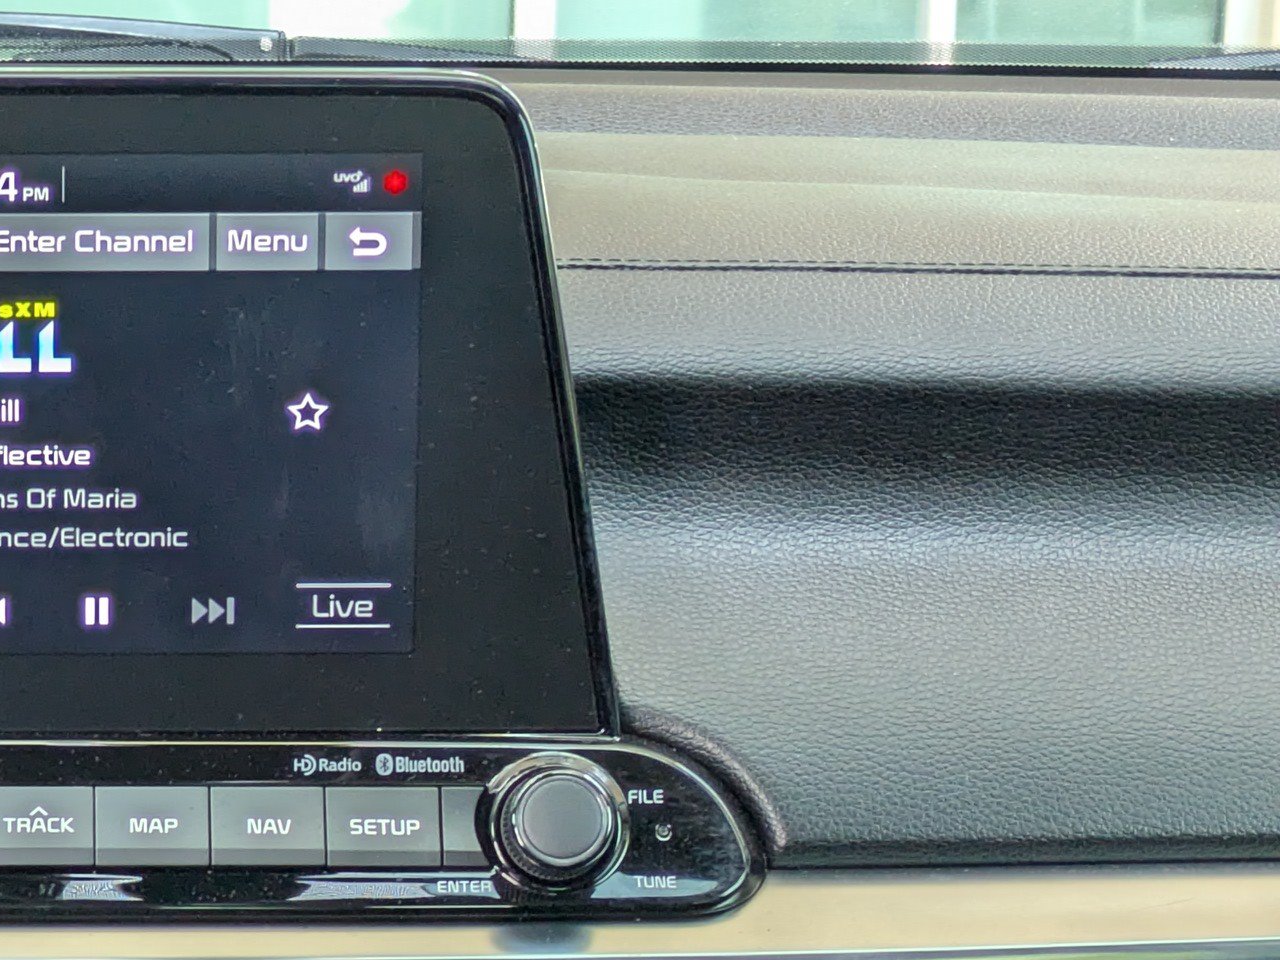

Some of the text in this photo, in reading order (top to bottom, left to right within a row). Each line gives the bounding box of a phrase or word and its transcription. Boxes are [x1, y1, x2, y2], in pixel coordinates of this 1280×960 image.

[22, 186, 50, 202] PM
[73, 229, 194, 253] Channel
[226, 229, 309, 253] Menu
[26, 489, 56, 509] Of
[63, 488, 137, 509] Maria
[312, 594, 374, 618] Live
[319, 758, 362, 772] Radio
[395, 756, 465, 773] Bluetooth
[627, 789, 664, 805] FILE
[2, 816, 75, 834] TRACK
[128, 817, 179, 834] MAP
[246, 818, 292, 835] NAV
[349, 818, 420, 836] SETUP
[436, 880, 492, 894] ENTER
[634, 875, 677, 889] TUNE
